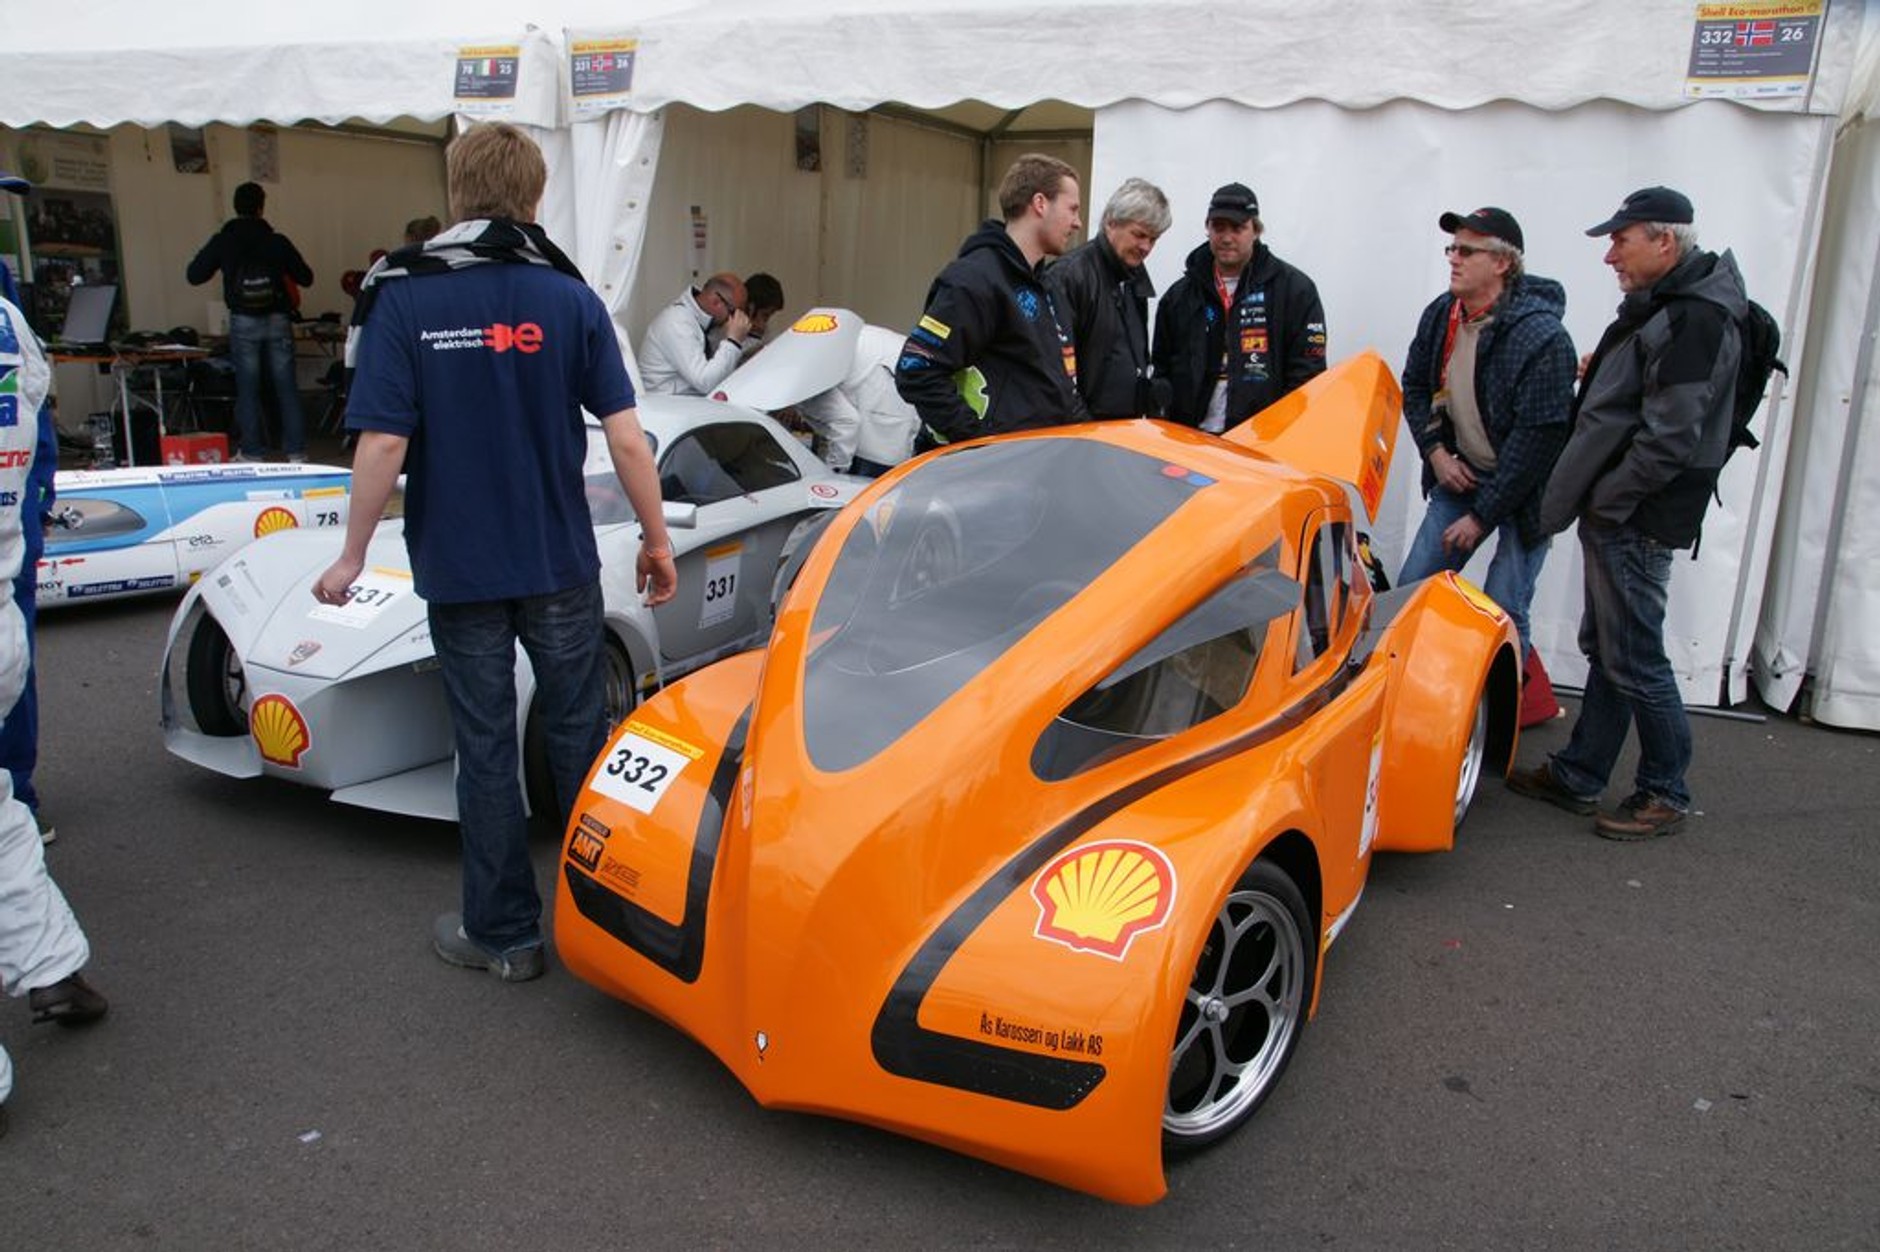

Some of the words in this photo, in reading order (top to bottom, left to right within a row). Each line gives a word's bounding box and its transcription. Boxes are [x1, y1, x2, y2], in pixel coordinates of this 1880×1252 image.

[1700, 7, 1726, 18] Shell
[1728, 4, 1805, 16] Eco-marathon
[1700, 30, 1733, 44] 332
[1780, 27, 1804, 42] 26
[420, 327, 483, 341] Amsterdam
[432, 338, 484, 350] elektrisch
[316, 511, 339, 527] 78
[706, 573, 736, 602] 331
[606, 748, 668, 793] 332
[1045, 1031, 1059, 1051] og
[1061, 1030, 1085, 1053] Lakk
[1087, 1034, 1103, 1056] AS
